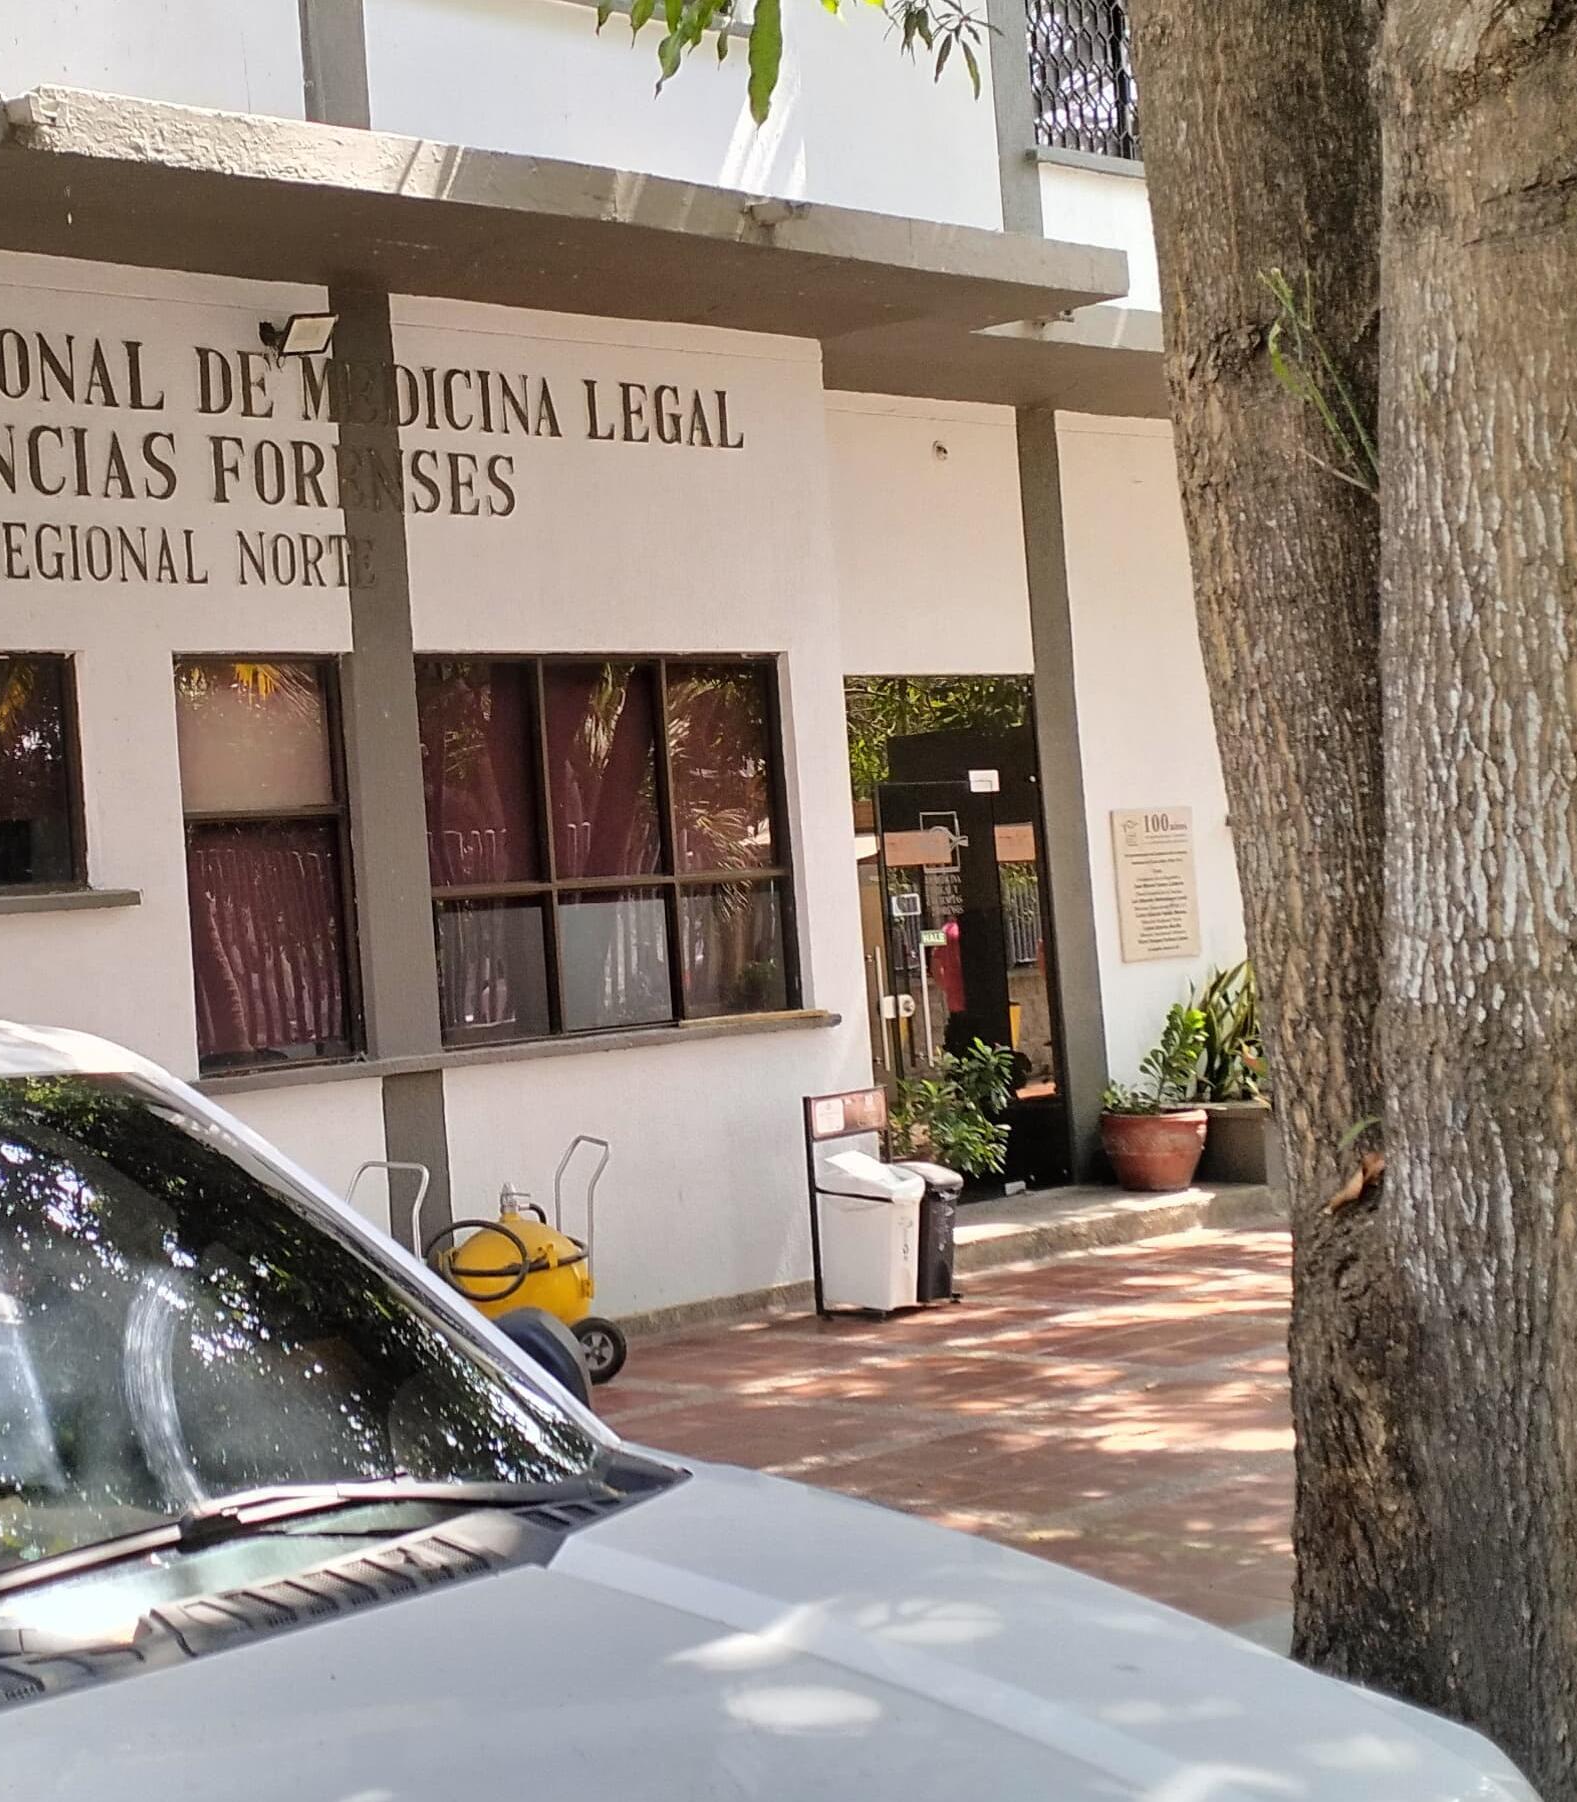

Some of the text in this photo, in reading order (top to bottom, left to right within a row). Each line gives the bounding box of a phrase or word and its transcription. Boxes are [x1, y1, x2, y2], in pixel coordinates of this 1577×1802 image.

[196, 345, 275, 421] DE
[301, 355, 563, 439] MEDICINA
[582, 378, 746, 450] LEGAL
[208, 434, 517, 518] FORENSES
[236, 529, 377, 590] NORTE
[1144, 813, 1169, 833] 100
